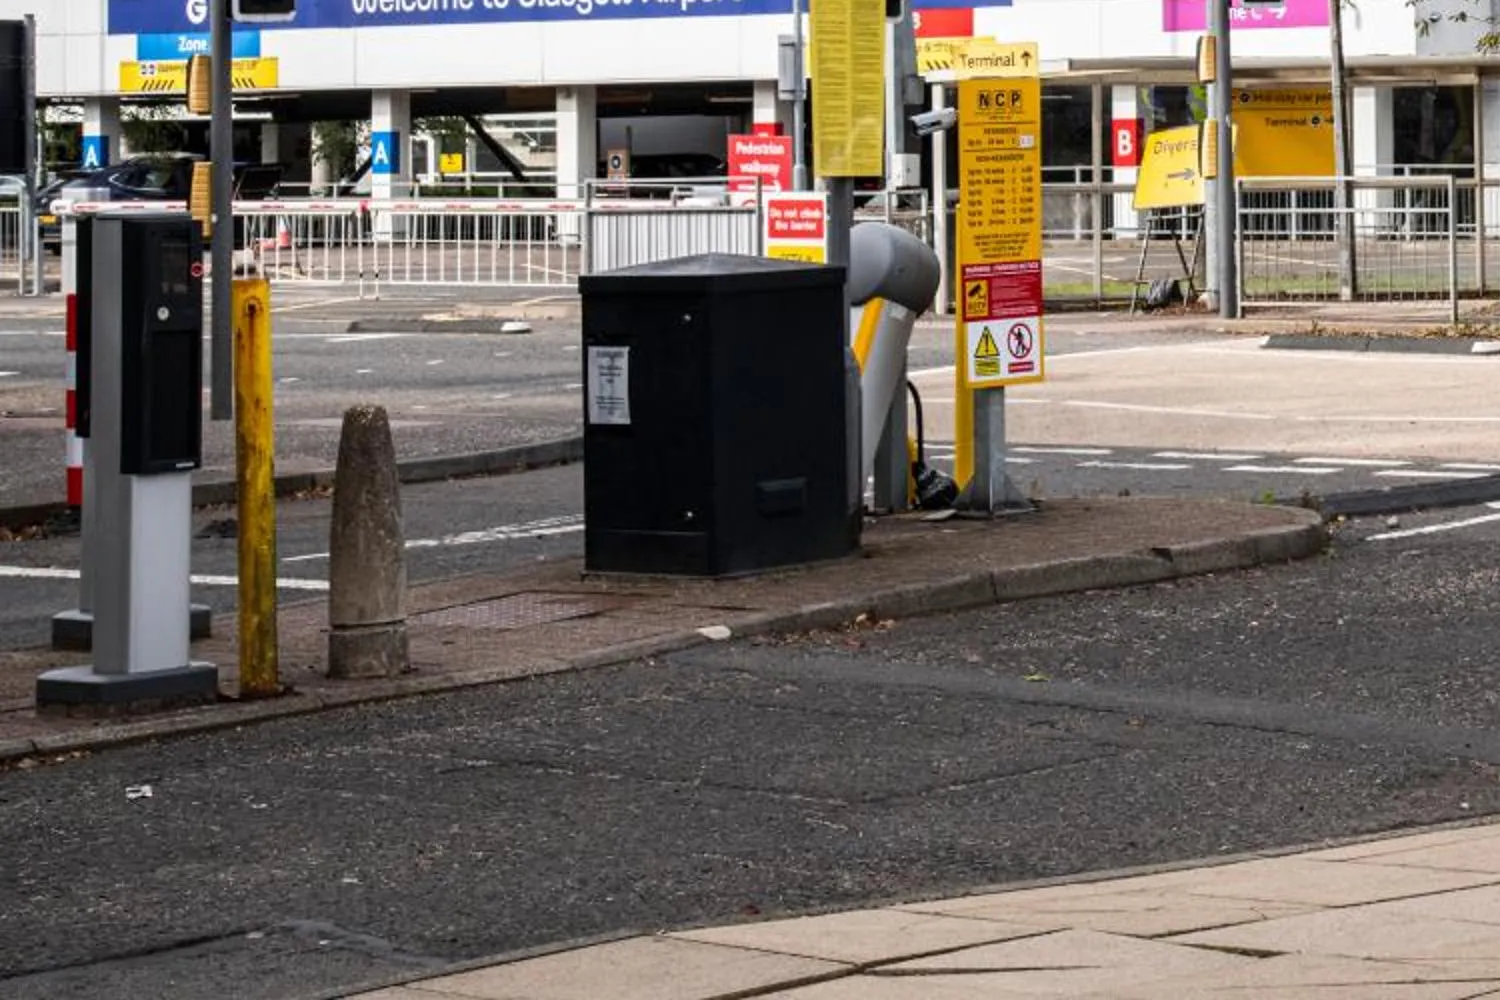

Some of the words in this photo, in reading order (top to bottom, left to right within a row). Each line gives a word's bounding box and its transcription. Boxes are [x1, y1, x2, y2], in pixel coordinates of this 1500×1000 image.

[177, 35, 209, 53] Zone
[959, 51, 1016, 69] Terminal
[979, 91, 1021, 108] NCP
[735, 141, 785, 156] Pedestrian
[1118, 129, 1133, 157] B
[84, 145, 99, 168] A
[374, 141, 389, 165] A
